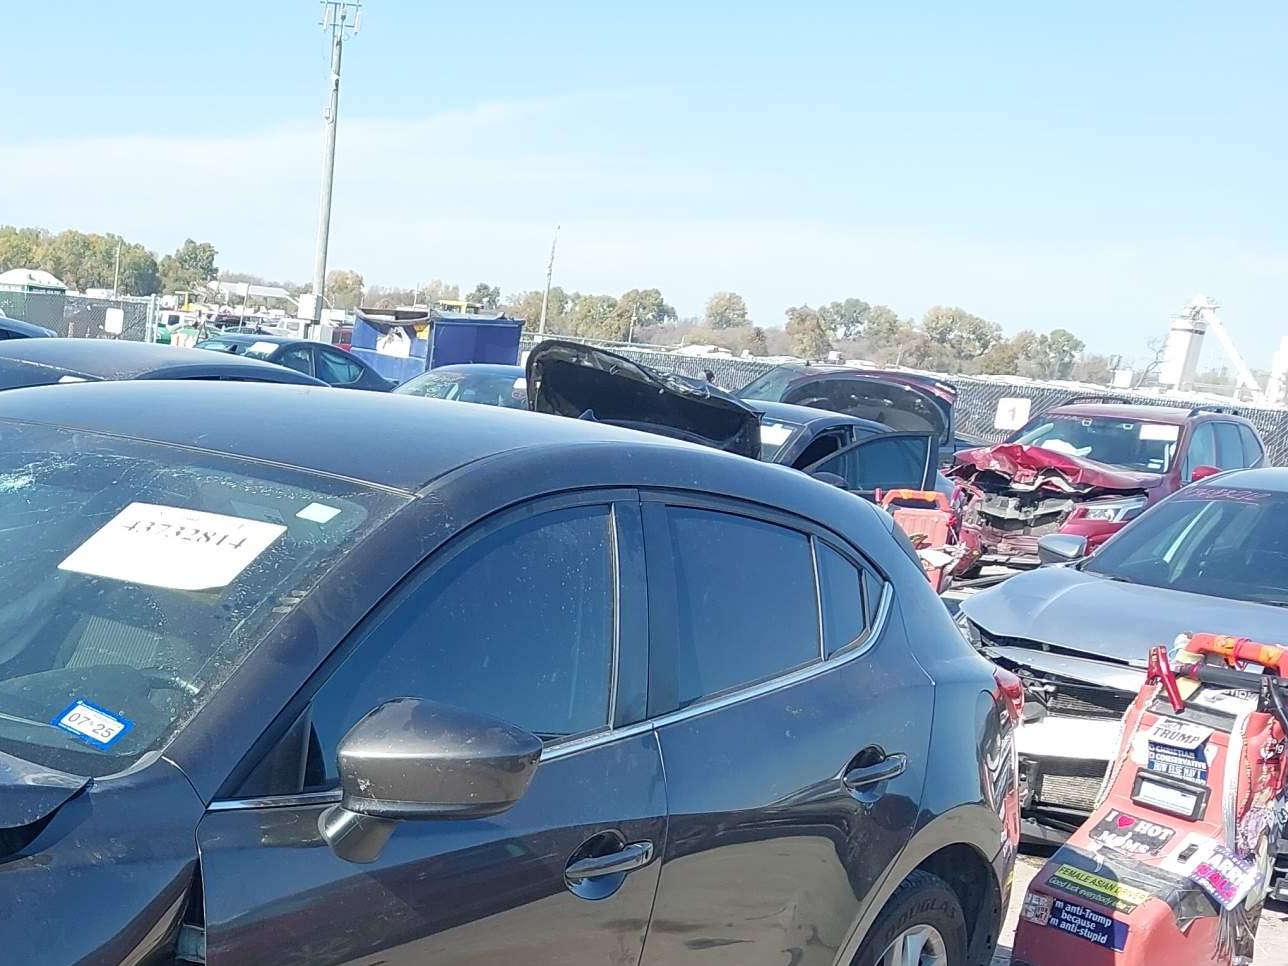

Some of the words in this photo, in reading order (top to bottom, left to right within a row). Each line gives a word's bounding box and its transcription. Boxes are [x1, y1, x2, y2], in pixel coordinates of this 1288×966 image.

[122, 519, 248, 550] 43732814
[1153, 727, 1201, 744] TRUMP
[1105, 811, 1119, 821] I
[1135, 820, 1170, 840] HOT
[1049, 876, 1066, 887] Good
[1058, 867, 1091, 885] FEMALE
[1090, 878, 1118, 893] ASIAN
[1061, 911, 1096, 930] because
[1065, 903, 1112, 927] anti-Trump
[1060, 919, 1108, 944] anti-stupid
